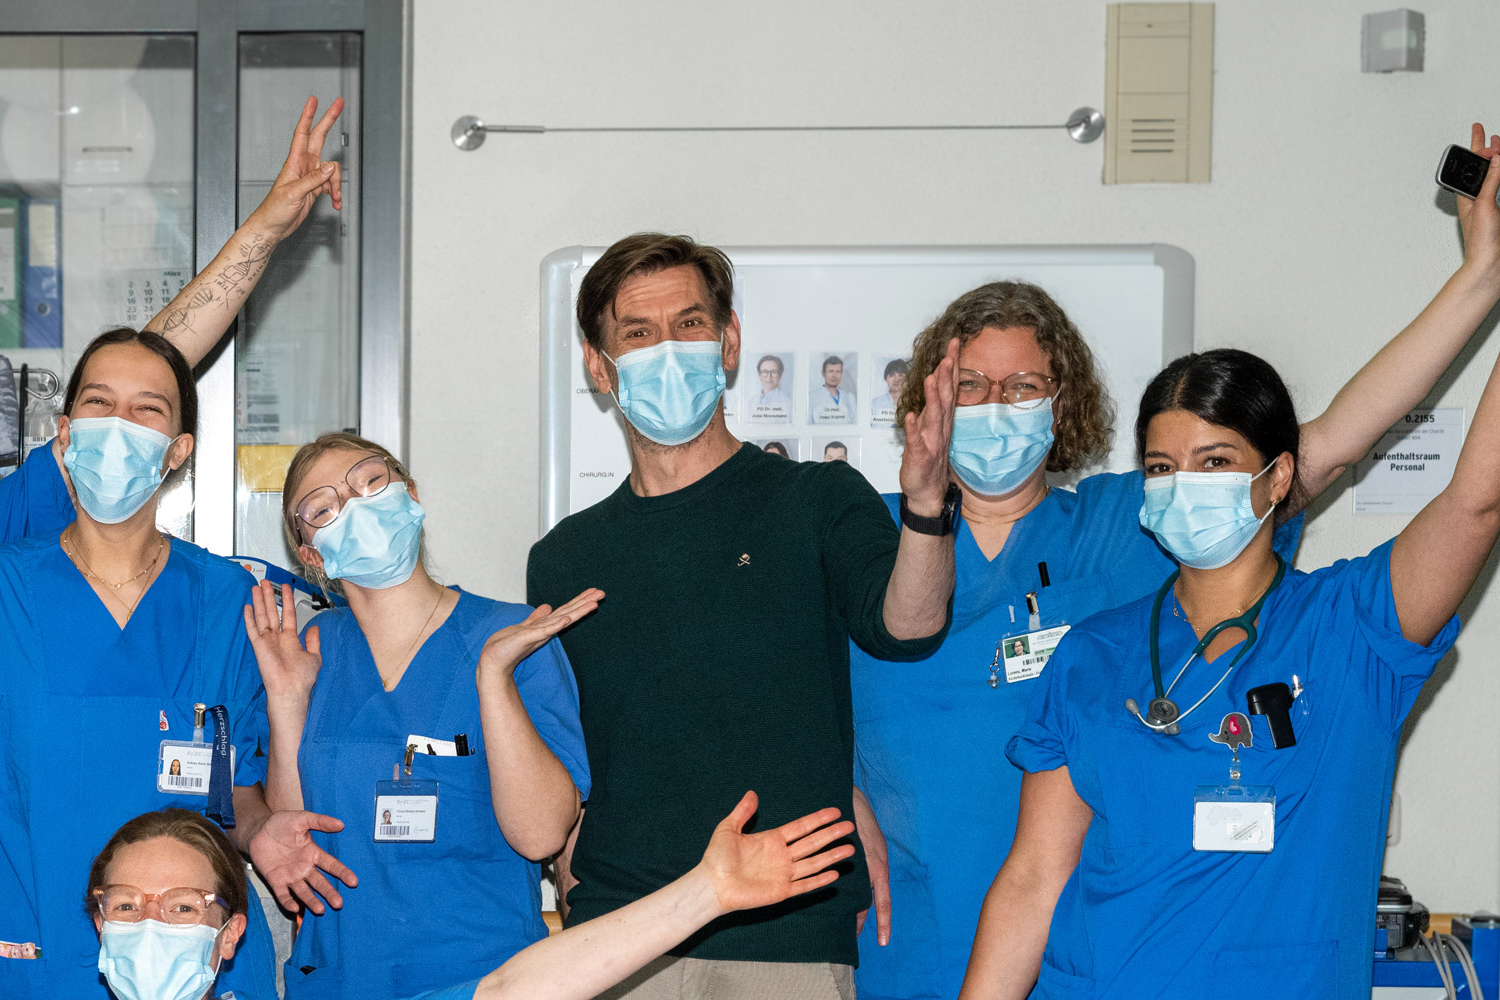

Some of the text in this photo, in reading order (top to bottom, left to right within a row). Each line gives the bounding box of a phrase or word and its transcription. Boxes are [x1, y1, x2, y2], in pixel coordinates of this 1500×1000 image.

[1405, 414, 1435, 423] 0.2155
[1373, 452, 1440, 461] Aufenthaltsraum
[1390, 463, 1425, 471] Personal
